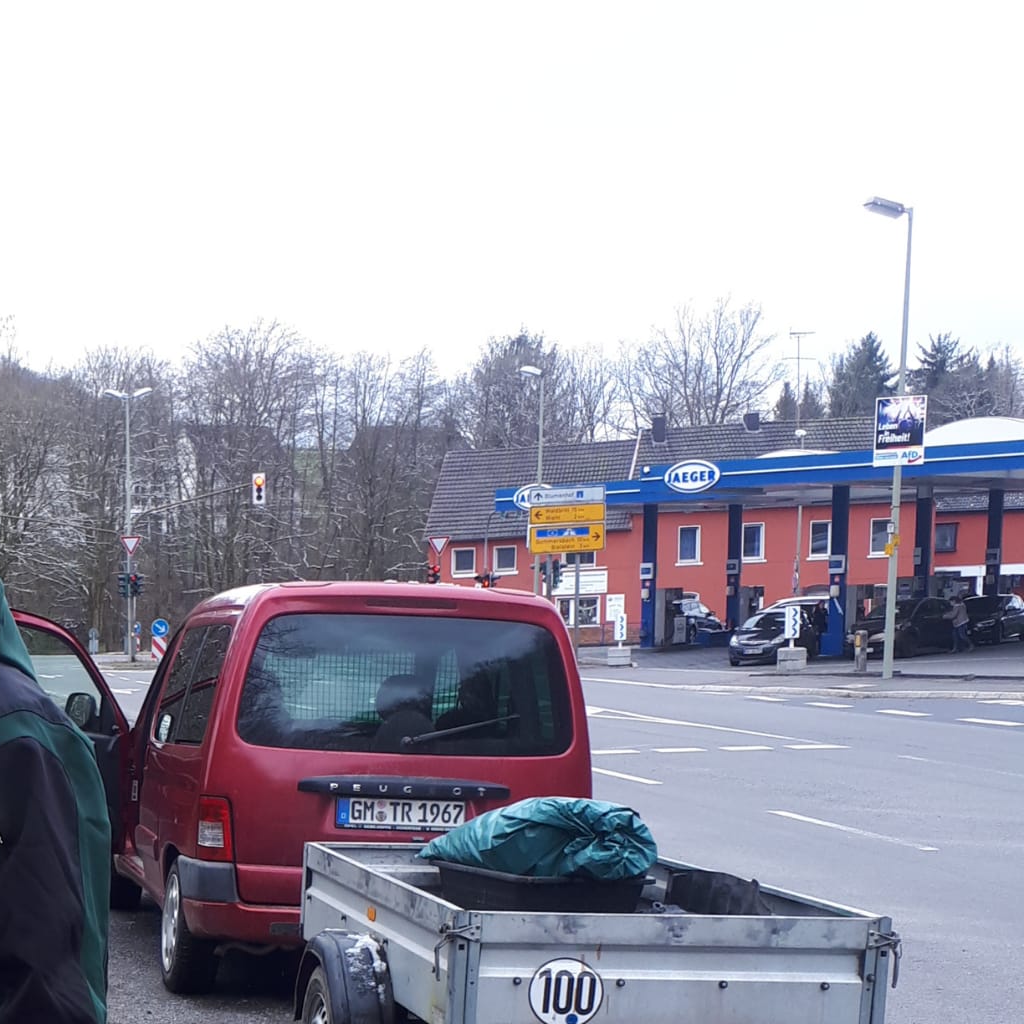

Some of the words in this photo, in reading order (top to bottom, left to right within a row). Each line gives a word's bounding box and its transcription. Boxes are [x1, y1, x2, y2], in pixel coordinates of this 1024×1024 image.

[878, 432, 911, 443] Freiheit!
[901, 451, 919, 459] AfD
[667, 470, 716, 483] JAEGER
[351, 801, 375, 821] GM
[389, 802, 413, 822] TR
[418, 803, 464, 824] 1967
[539, 968, 597, 1016] 100
